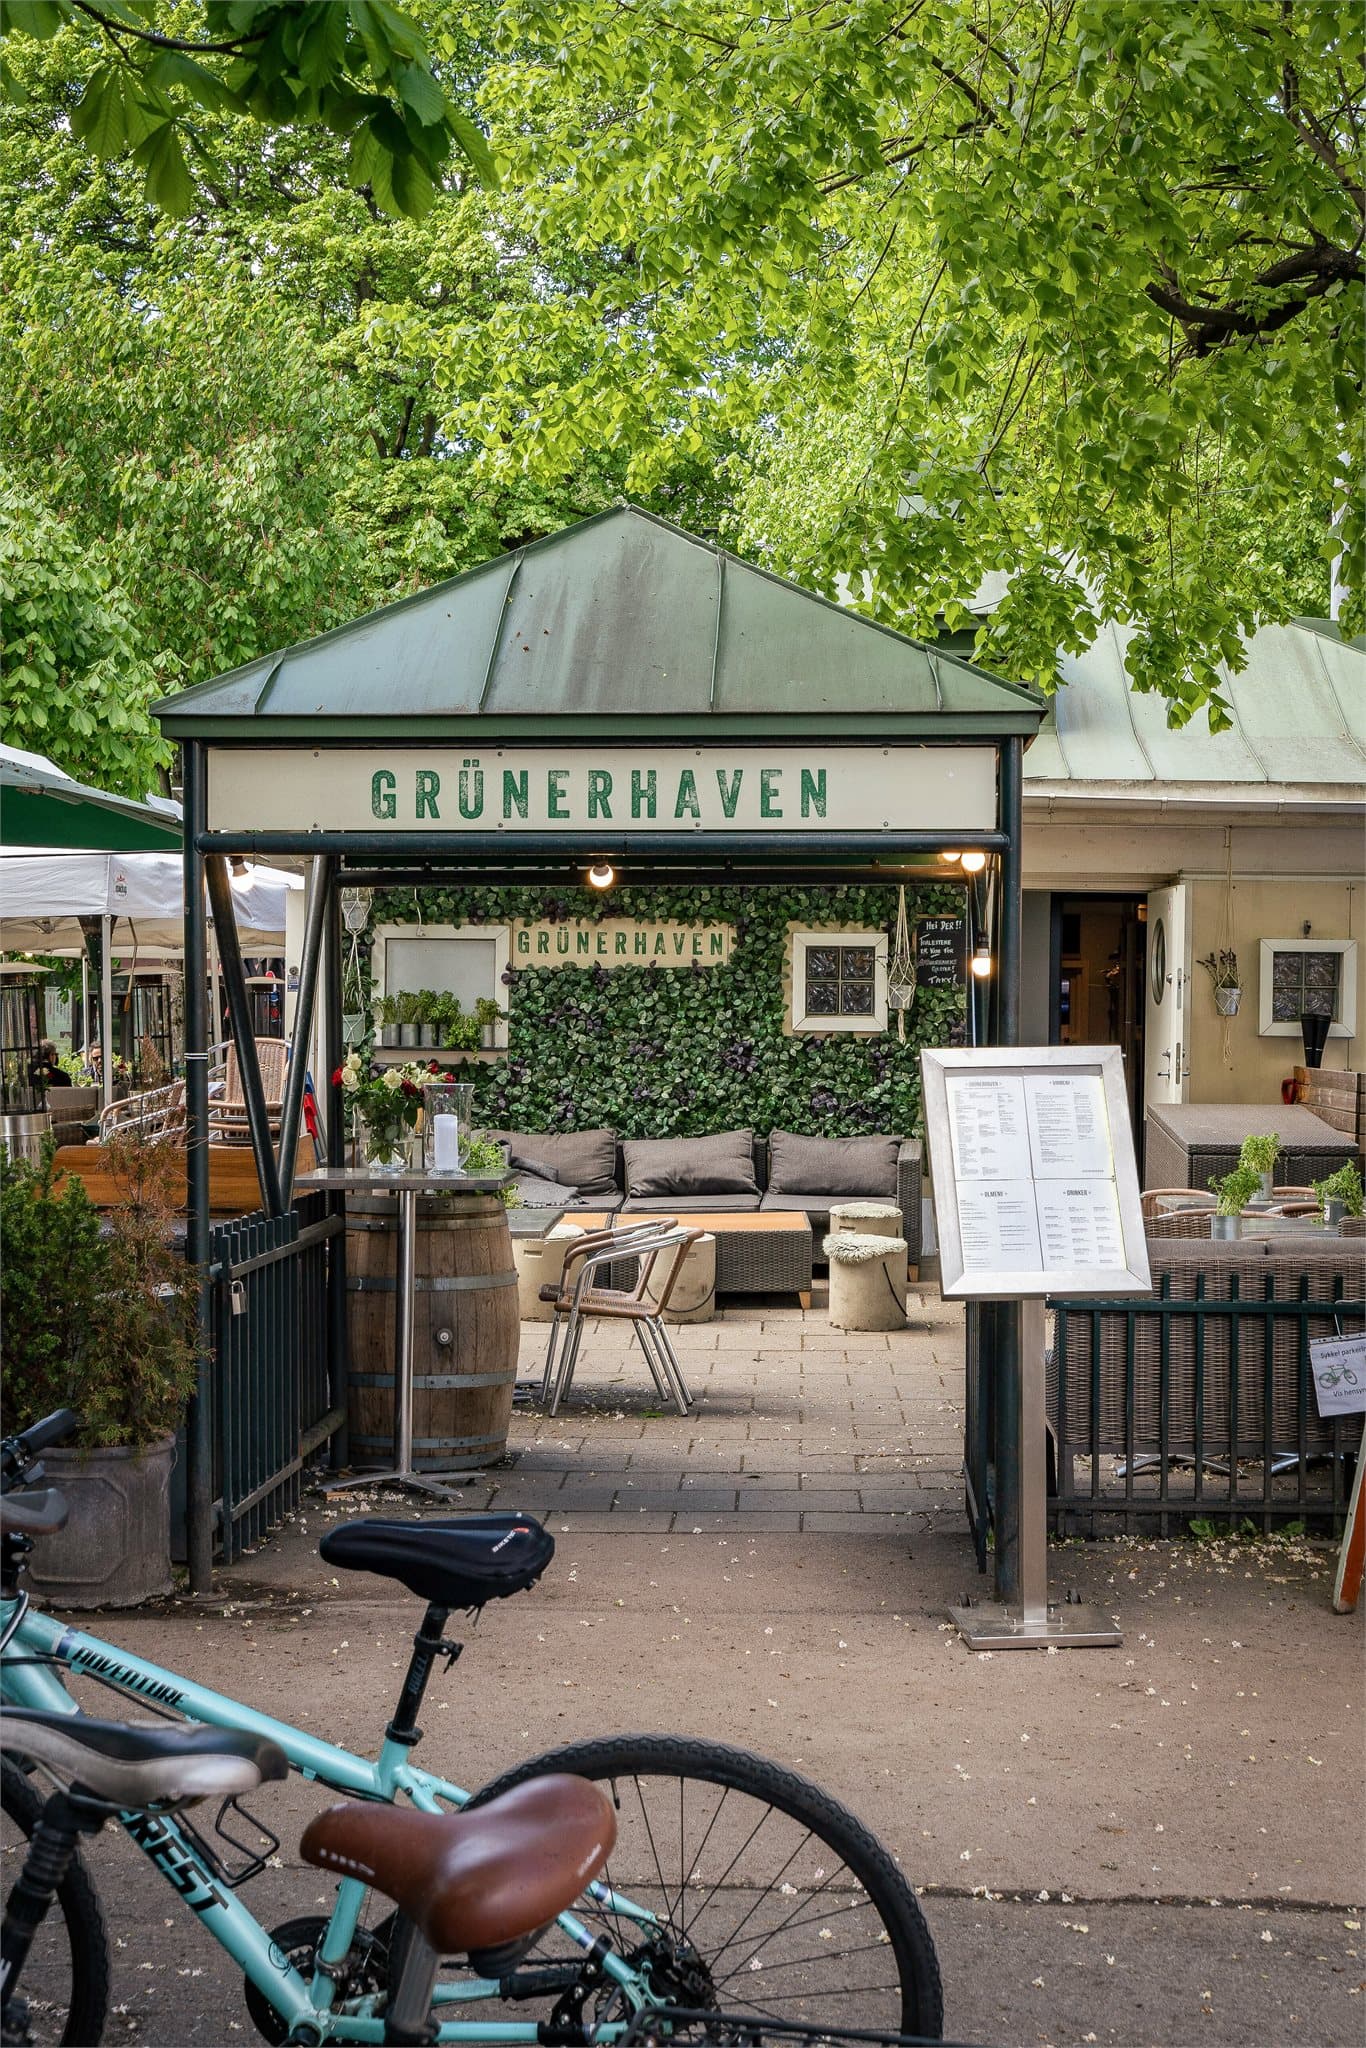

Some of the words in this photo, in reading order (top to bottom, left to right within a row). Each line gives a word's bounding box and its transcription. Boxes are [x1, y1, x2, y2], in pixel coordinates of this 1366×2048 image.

[371, 759, 828, 820] GRÜNERHAVEN
[517, 926, 724, 956] GRÜNERHAVEN
[1320, 1350, 1340, 1359] Sykkel
[71, 1646, 190, 1706] ADVENTURE
